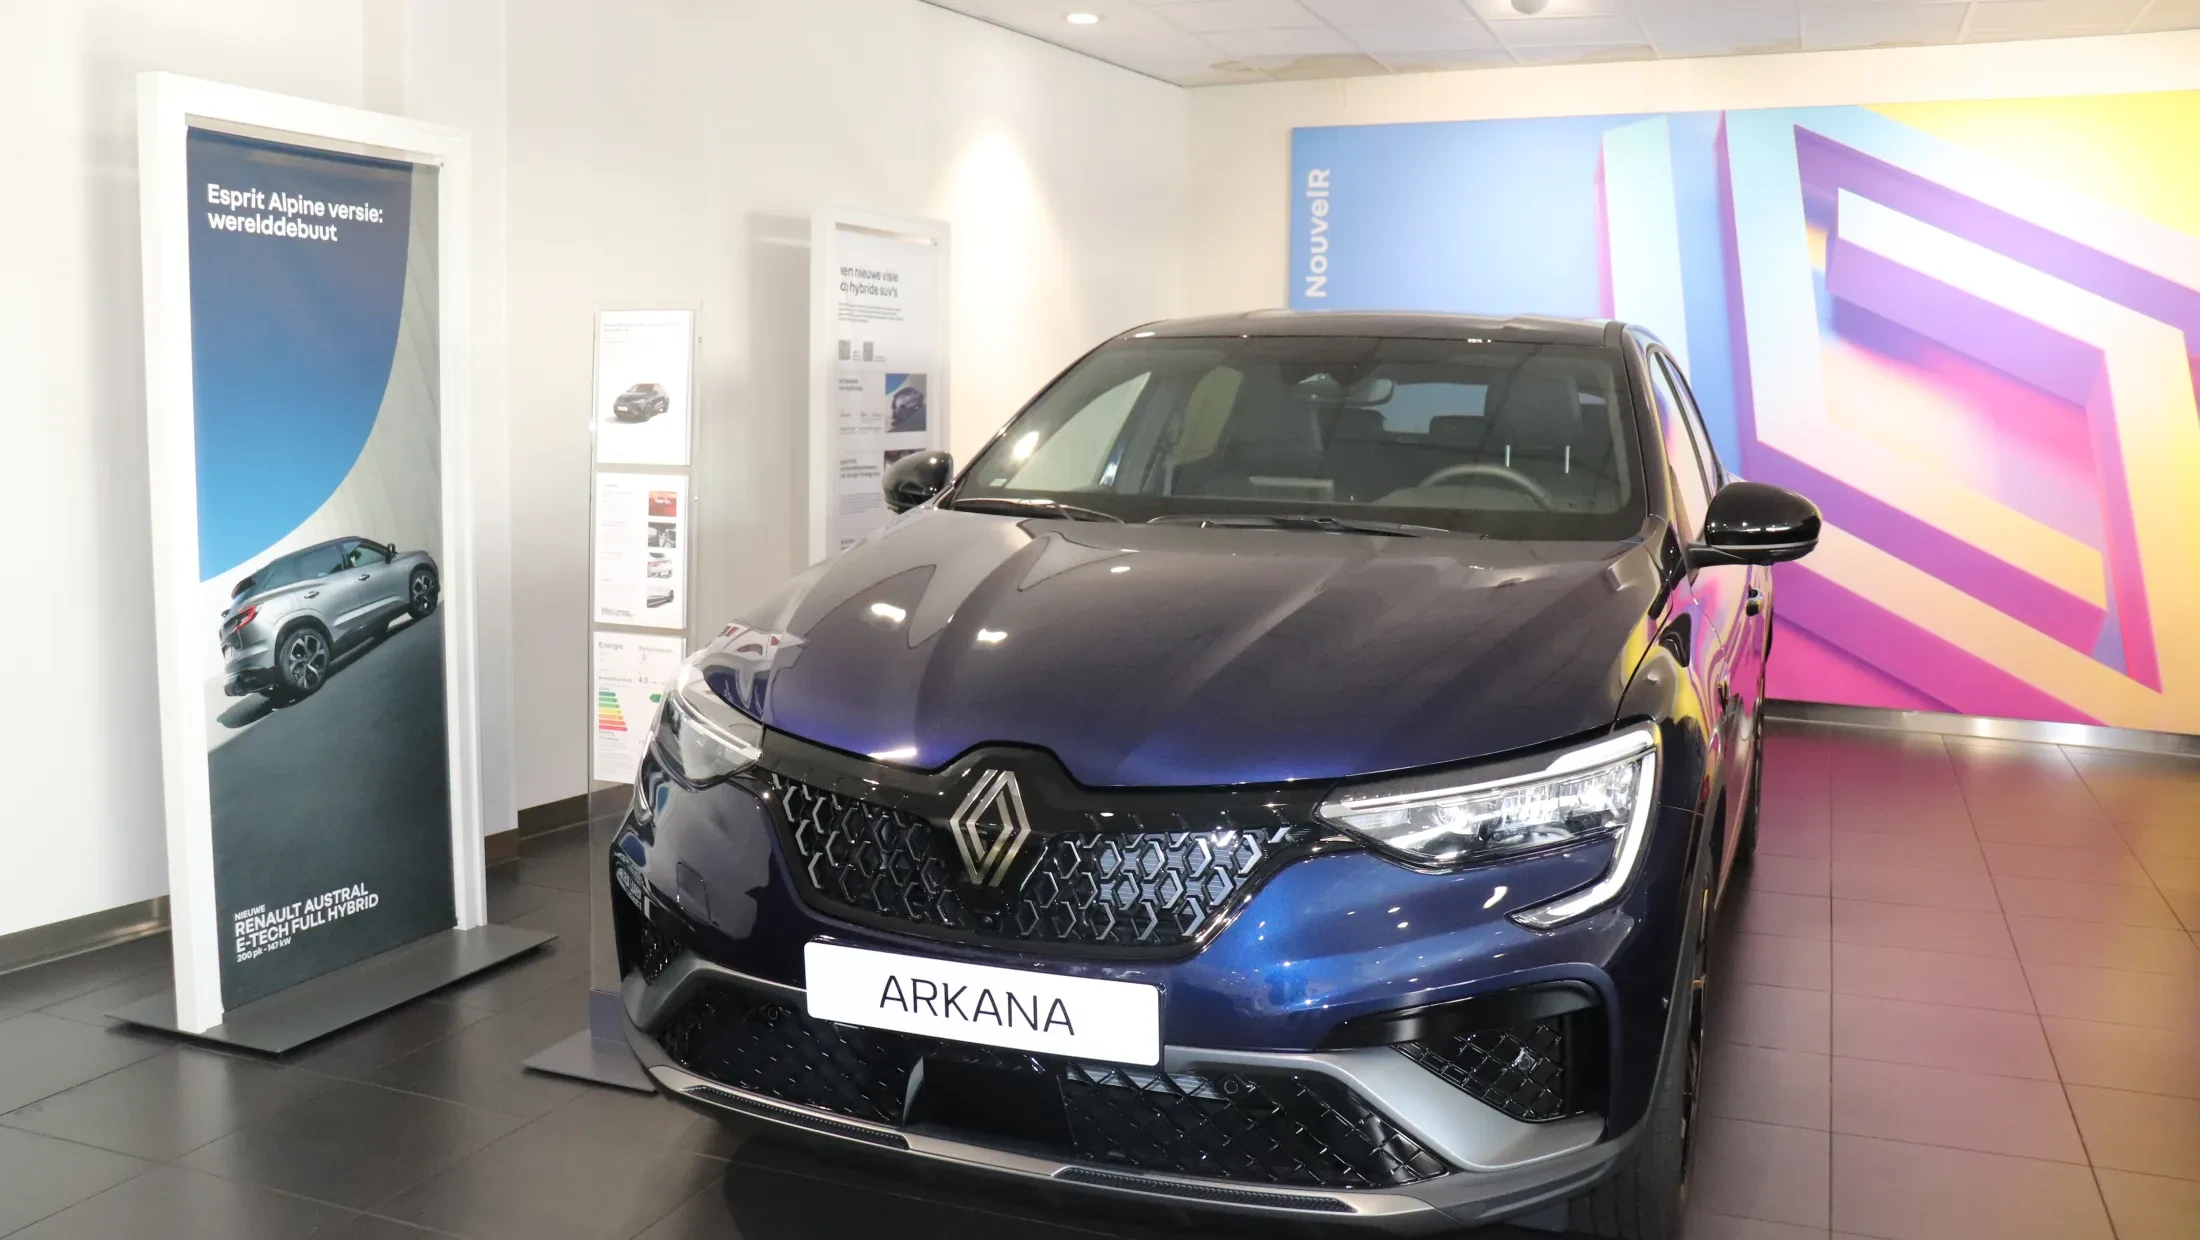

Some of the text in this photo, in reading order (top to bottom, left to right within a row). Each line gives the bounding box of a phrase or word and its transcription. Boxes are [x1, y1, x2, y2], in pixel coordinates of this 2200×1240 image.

[207, 183, 384, 223] Esprit Alpine versie:
[207, 212, 338, 242] werelddebuut
[855, 266, 881, 281] nieuwe
[882, 270, 899, 282] visie
[849, 280, 878, 297] hybride
[880, 286, 898, 298] suv's
[599, 641, 624, 651] Energie
[234, 904, 266, 921] NIEUWE
[235, 882, 368, 937] RENAULT AUSTRAL
[236, 893, 379, 953] E-TECH FULL HYBRID
[237, 951, 252, 962] 200
[253, 947, 263, 958] pk
[267, 941, 279, 951] 147
[280, 937, 291, 947] kW
[879, 975, 1075, 1036] ARKANA
